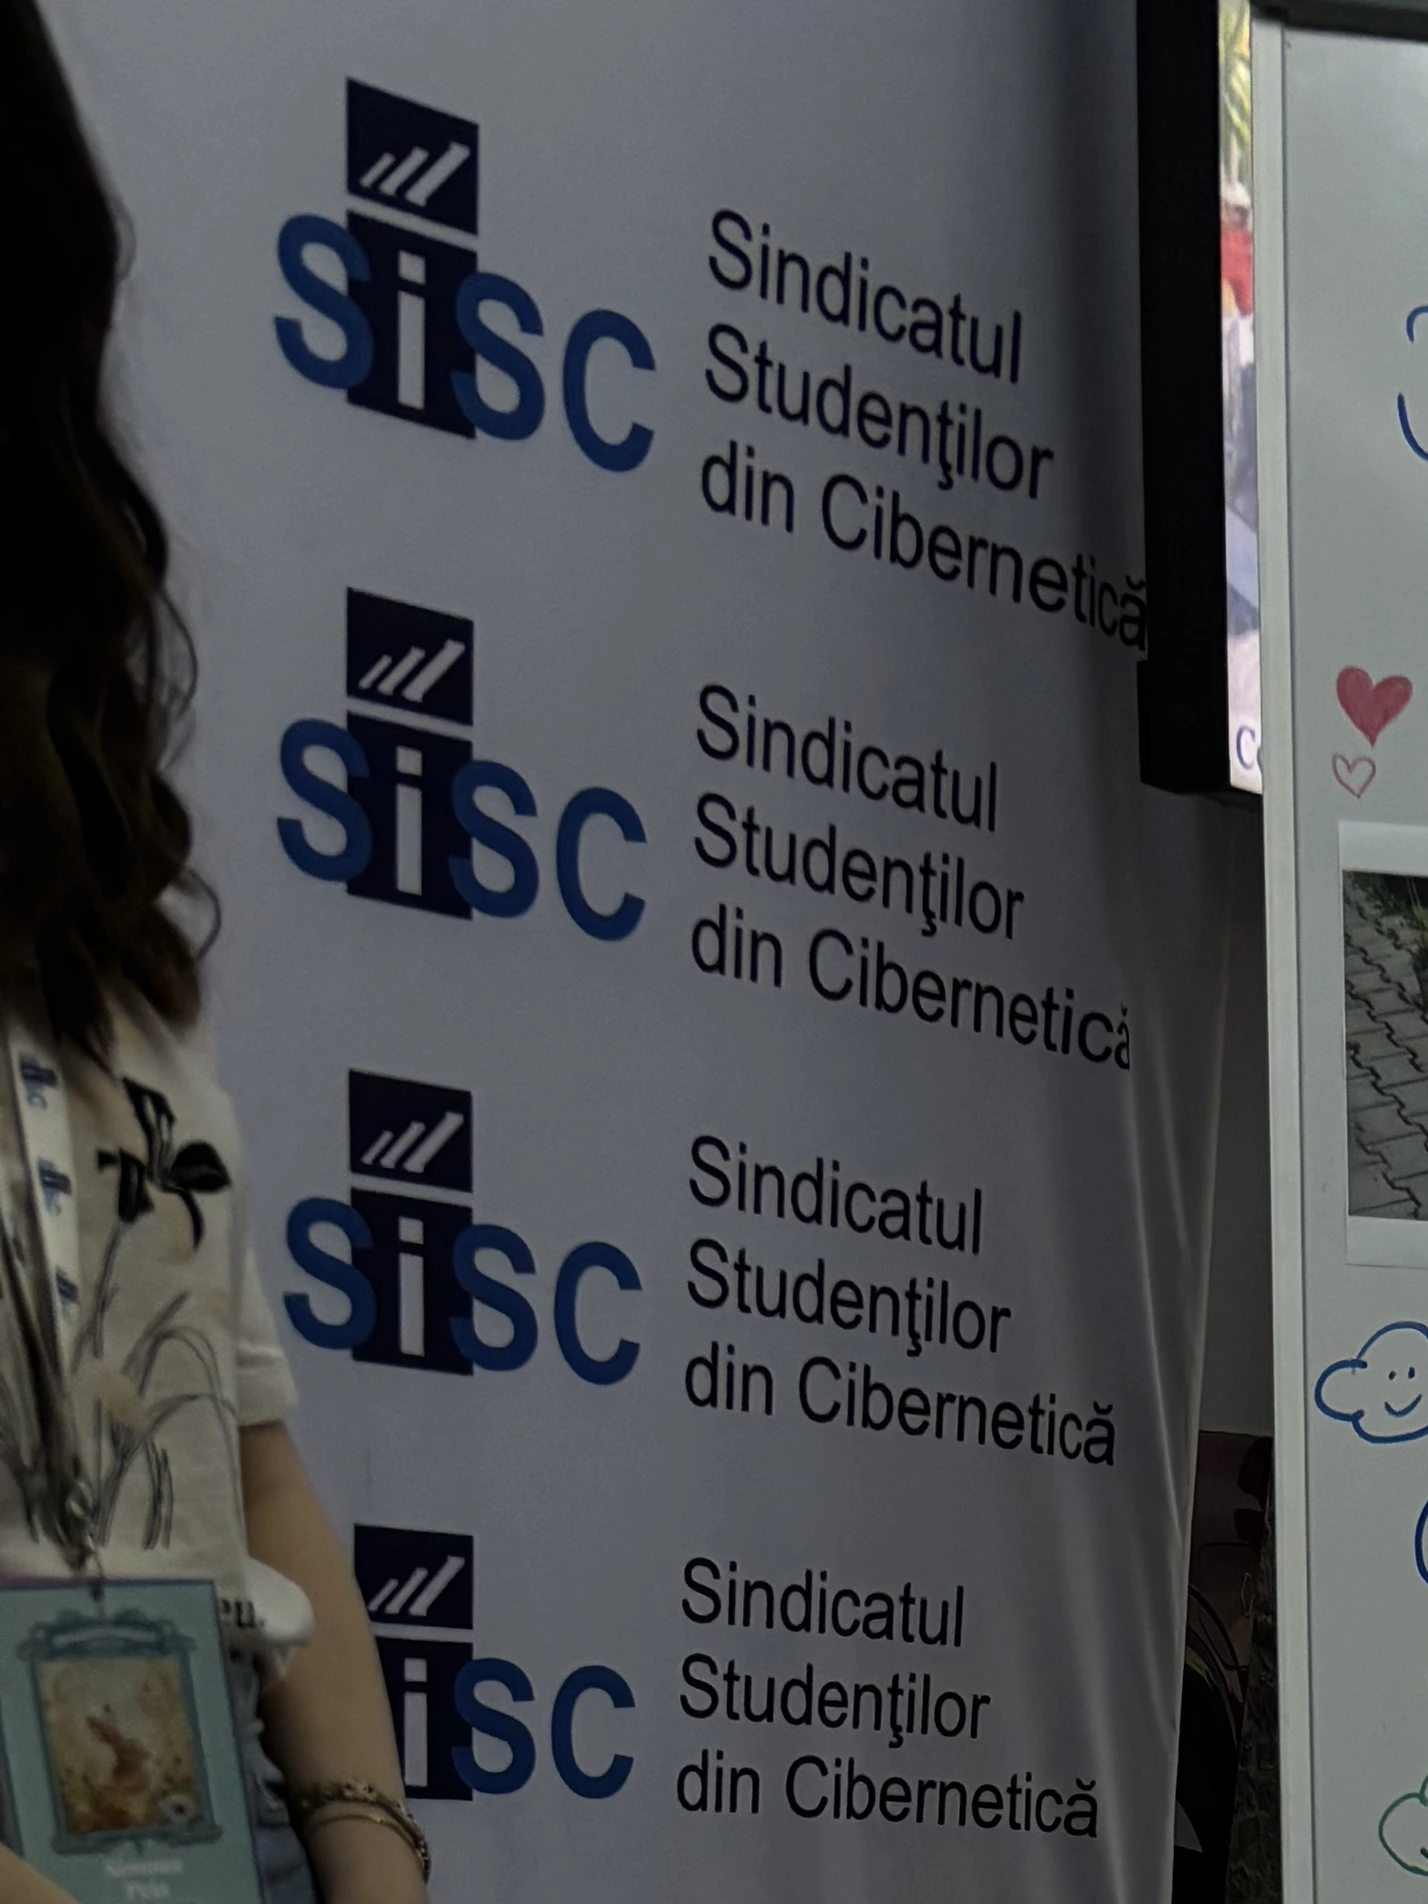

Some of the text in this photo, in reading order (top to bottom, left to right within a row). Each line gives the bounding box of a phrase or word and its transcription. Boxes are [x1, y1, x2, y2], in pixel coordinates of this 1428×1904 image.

[707, 208, 1023, 385] Sindicatul
[700, 440, 1146, 651] din Cibernetică
[696, 683, 998, 833] Sindicatul
[1235, 724, 1263, 770] C
[690, 903, 783, 987] din
[688, 1133, 984, 1255] Sindicatul
[683, 1342, 1116, 1467] din Cibernetică
[681, 1556, 966, 1649] Sindicatul
[676, 1749, 1100, 1839] din Cibernetică
